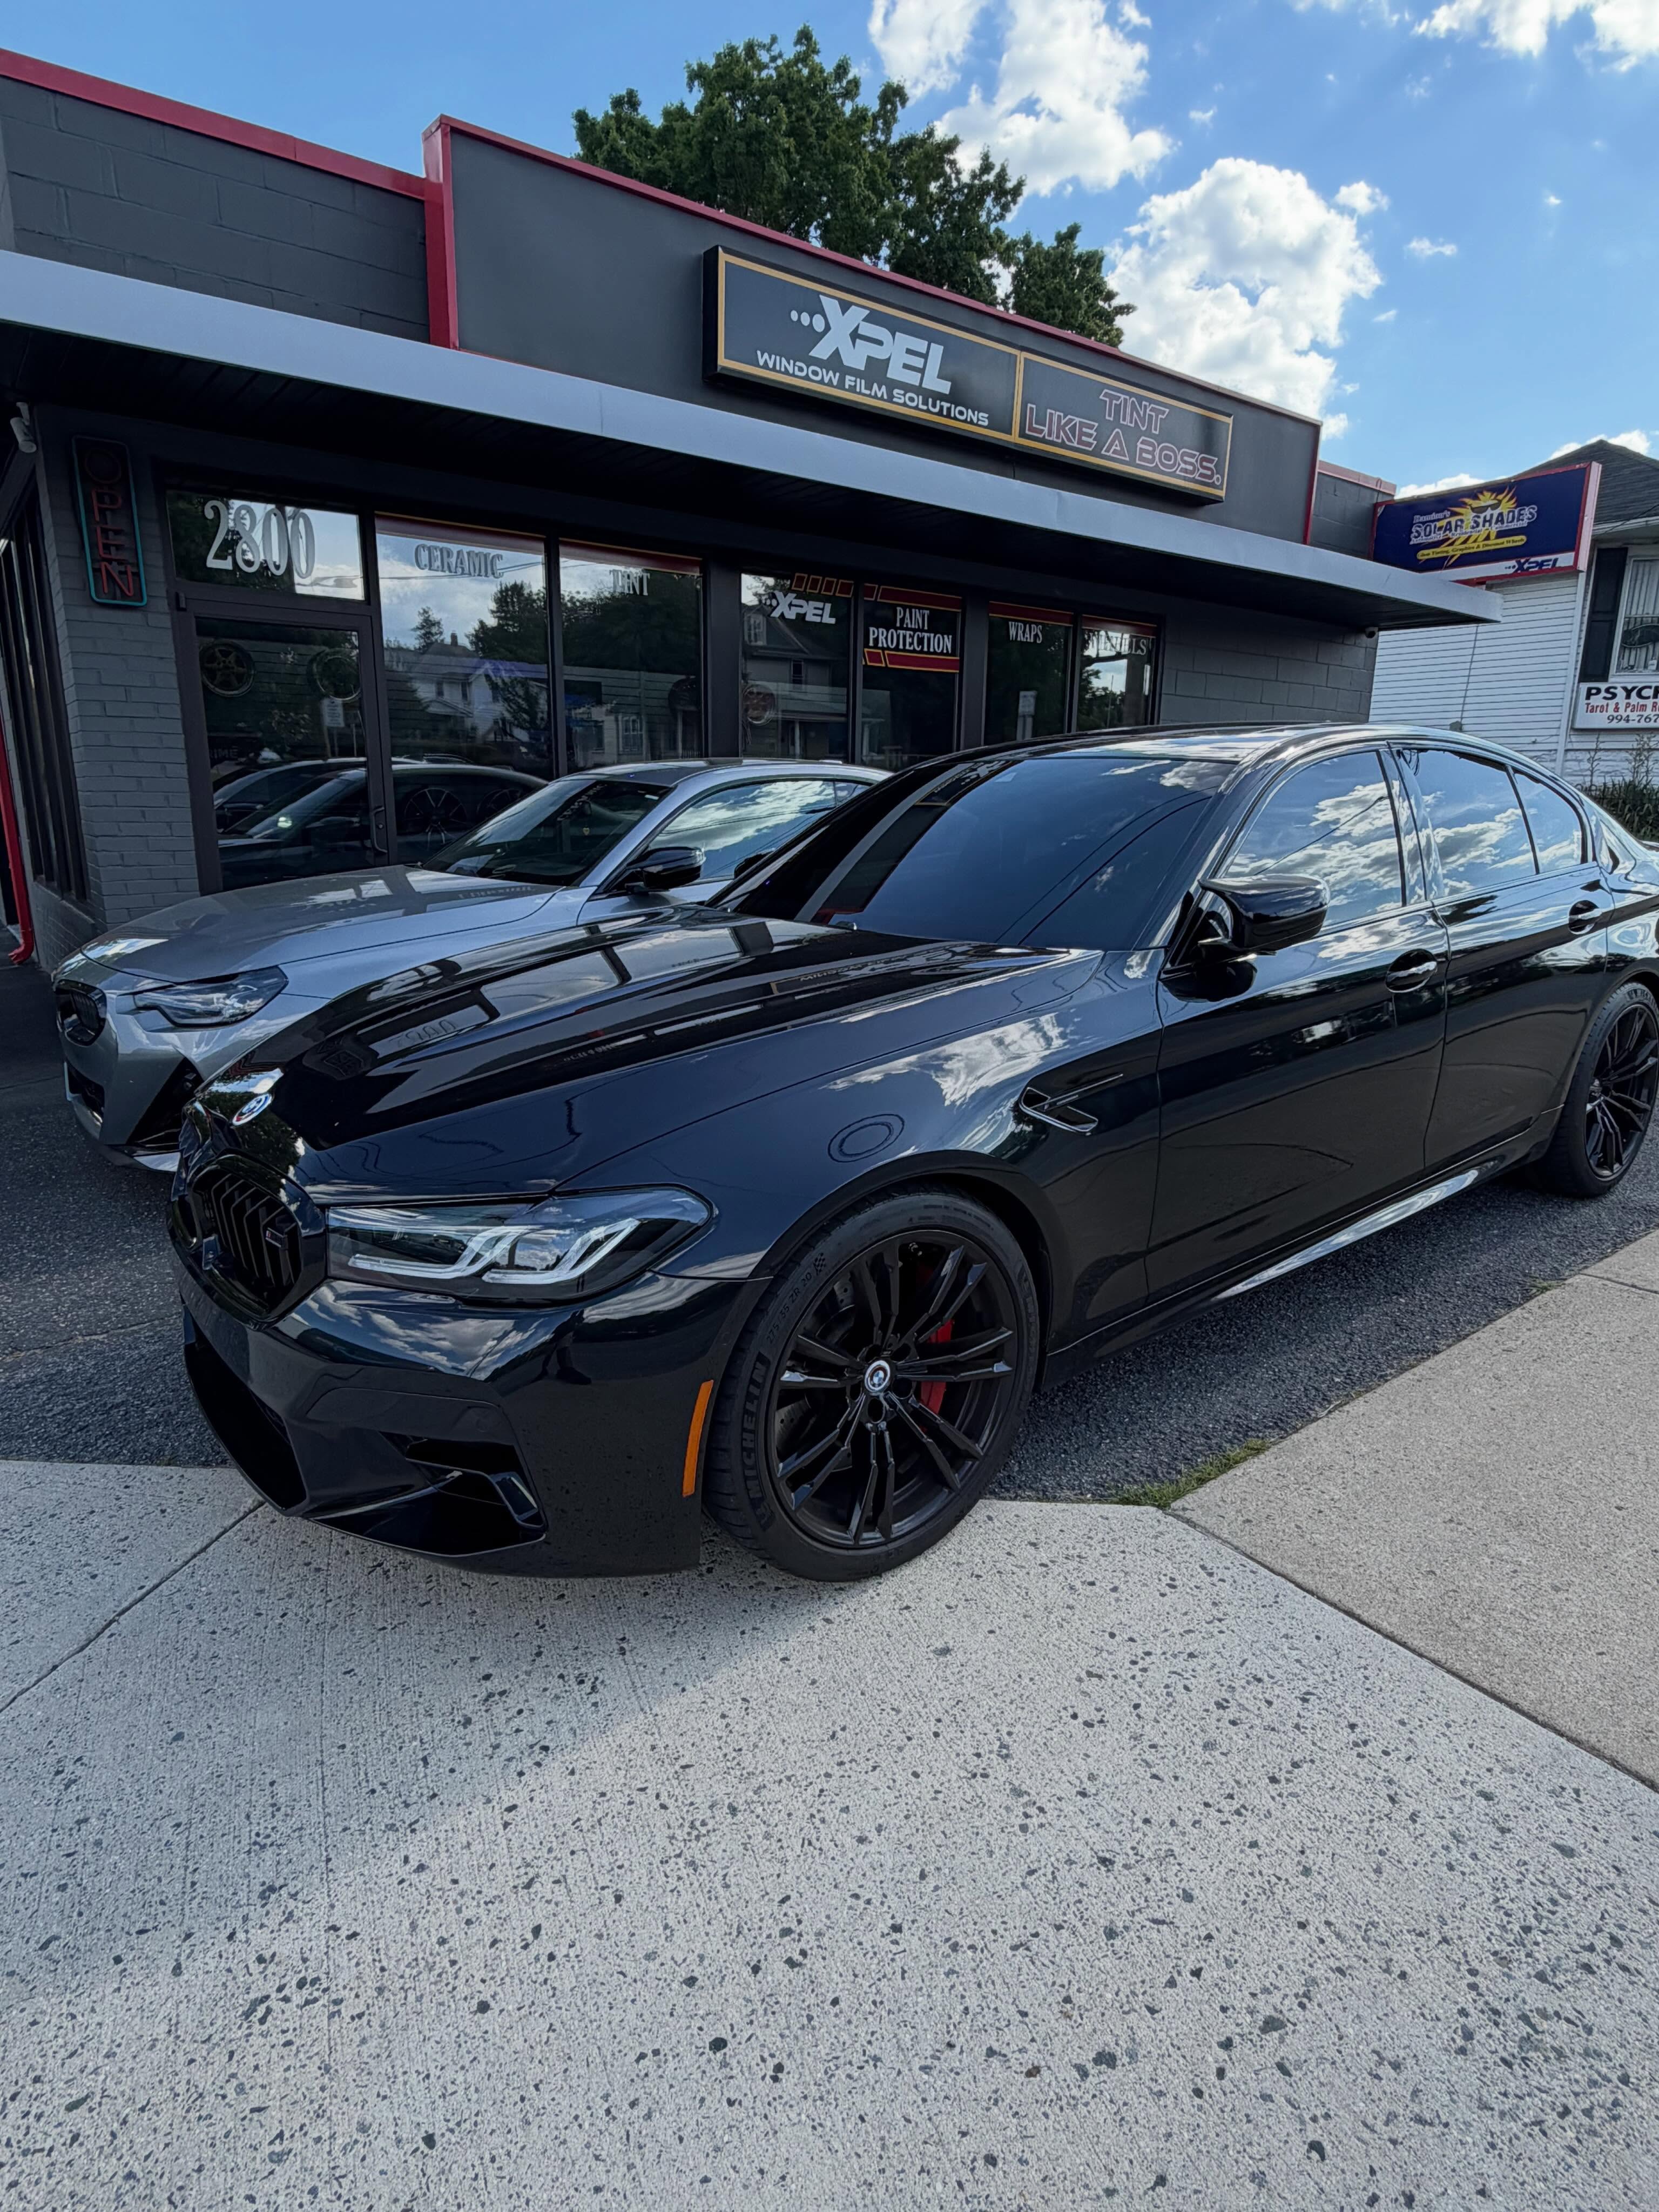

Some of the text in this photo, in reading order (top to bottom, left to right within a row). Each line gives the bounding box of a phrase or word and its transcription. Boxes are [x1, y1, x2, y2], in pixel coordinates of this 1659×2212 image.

[809, 294, 952, 394] XPEL
[756, 350, 989, 427] WINDOW FILM SOLUTIONS
[1100, 389, 1169, 434] TINT
[1026, 403, 1222, 485] LIKE A BOSS.
[84, 449, 134, 596] OPEN
[204, 500, 315, 578] 2800
[1411, 505, 1537, 540] SOLAR SHADES
[414, 543, 504, 579] CERAMIC
[770, 591, 836, 624] XPEL
[896, 606, 930, 630] PAINT
[869, 627, 953, 654] PROTECTION
[1008, 621, 1043, 644] WRAPS
[1585, 702, 1609, 713] Tarot
[1613, 702, 1620, 712] &
[1624, 702, 1647, 712] Palm
